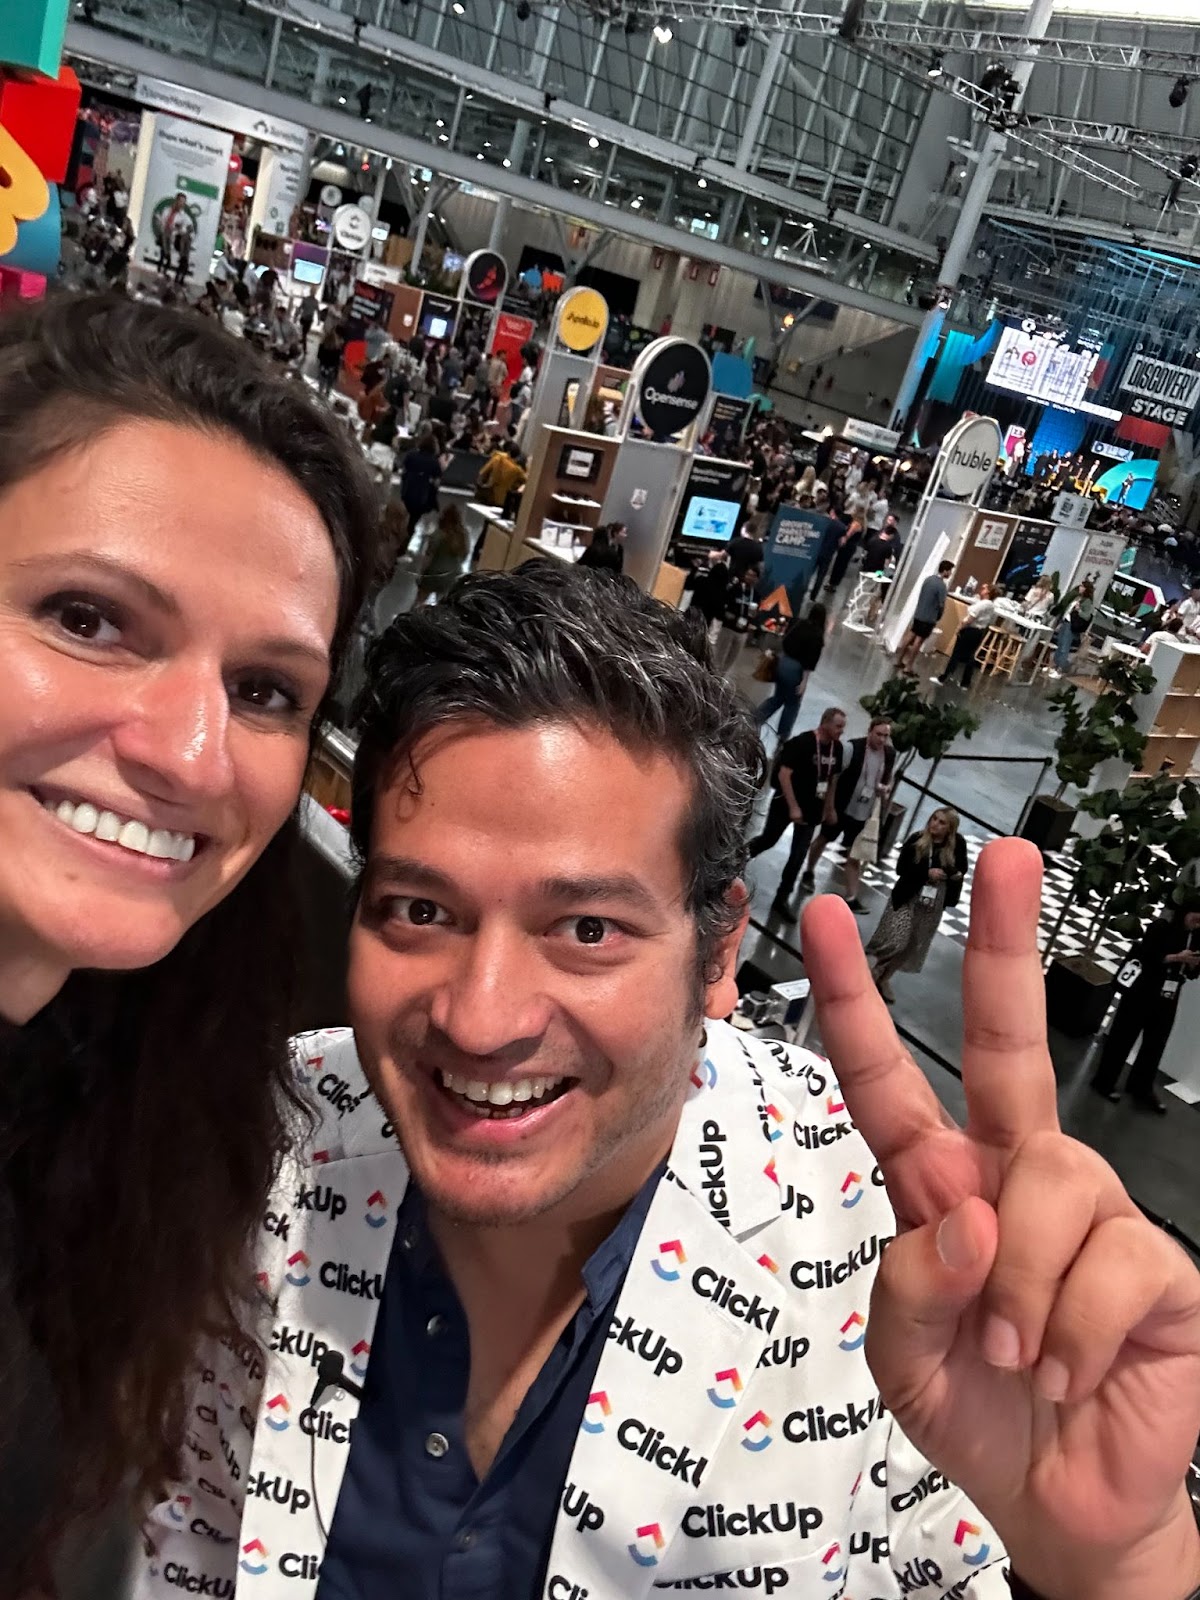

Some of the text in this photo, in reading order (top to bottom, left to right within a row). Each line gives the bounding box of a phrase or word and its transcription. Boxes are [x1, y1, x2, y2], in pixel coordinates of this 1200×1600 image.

[644, 386, 699, 410] Opensense
[1127, 358, 1199, 404] DISCOVERY
[1131, 398, 1188, 426] STAGE
[951, 444, 992, 472] huble
[793, 1121, 858, 1149] Click
[294, 1183, 347, 1221] kUp
[783, 1398, 889, 1443] Click
[562, 1482, 605, 1533] Up
[681, 1502, 823, 1539] ClickUp
[164, 1562, 236, 1600] ClickU
[278, 1552, 321, 1580] Cli
